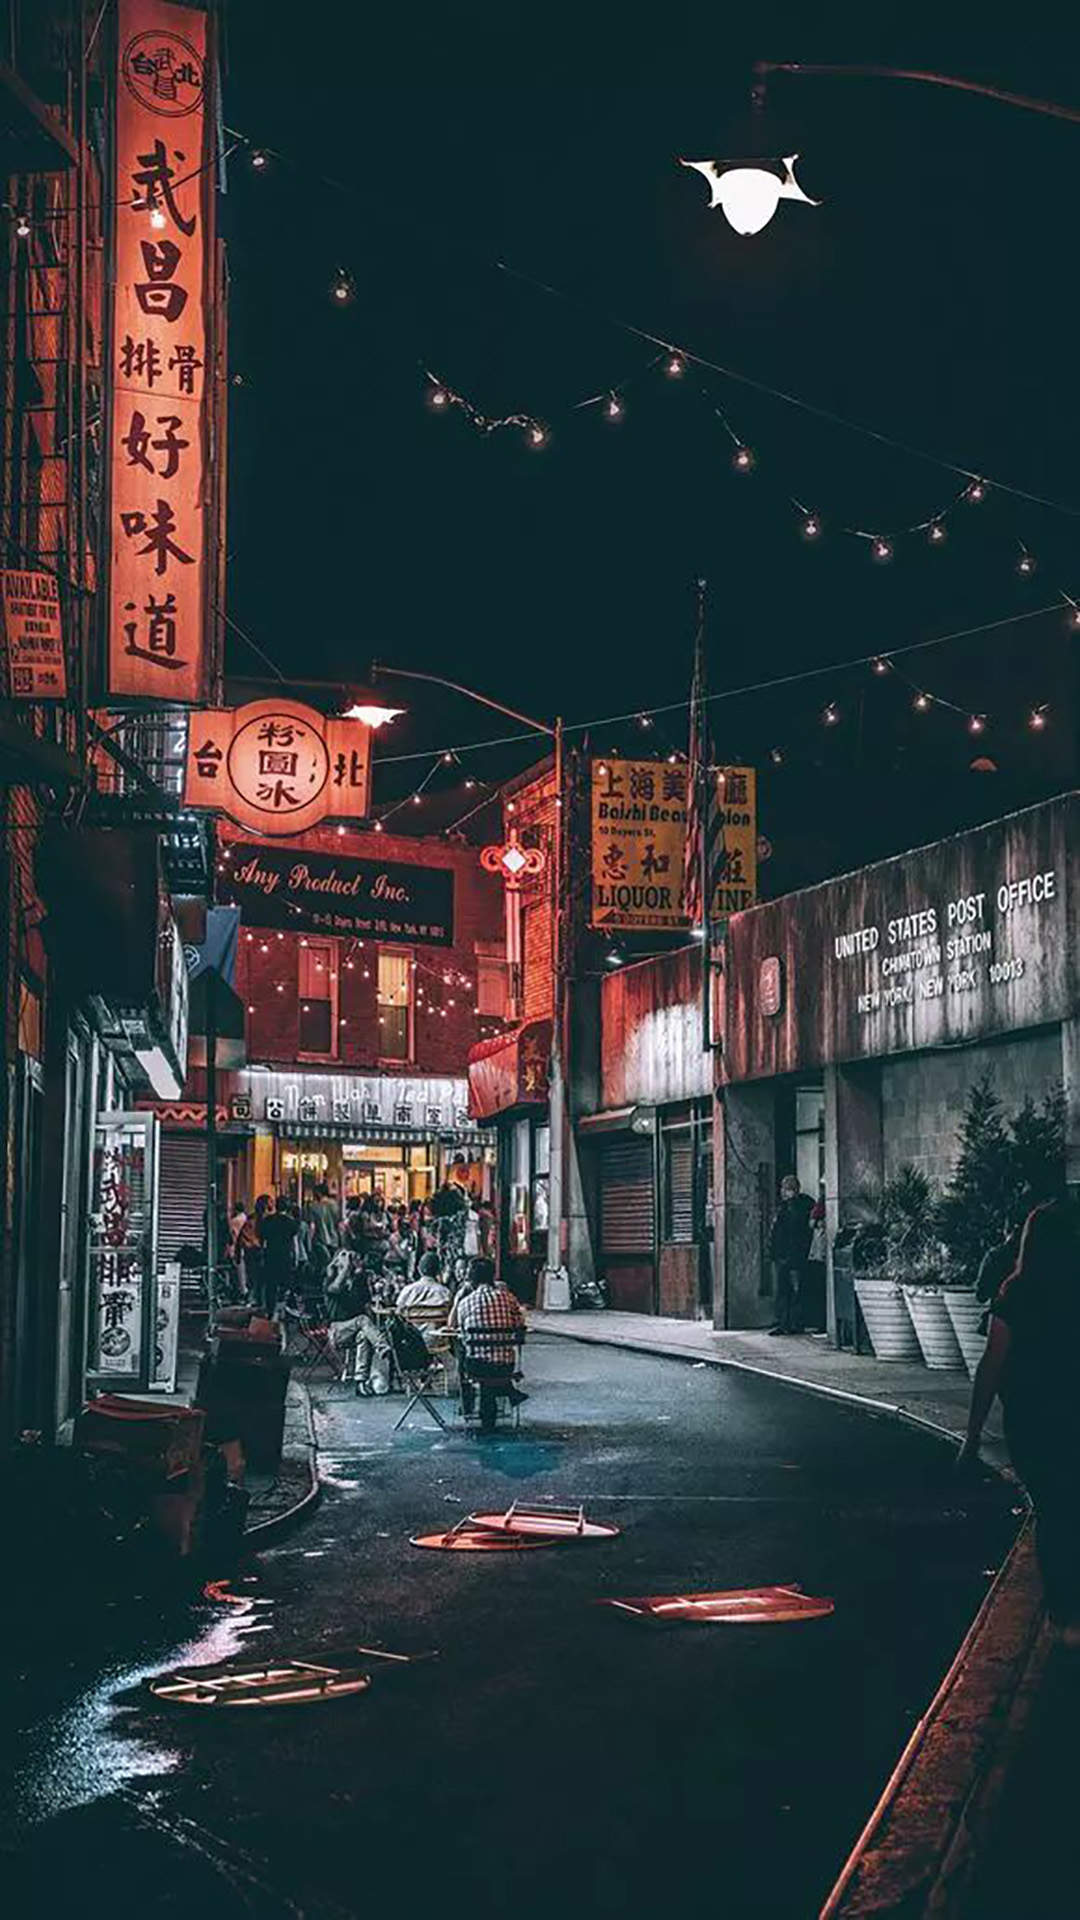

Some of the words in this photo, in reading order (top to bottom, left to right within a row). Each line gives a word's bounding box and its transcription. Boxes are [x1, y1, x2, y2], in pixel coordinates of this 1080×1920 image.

[234, 858, 280, 894] Any
[288, 864, 362, 896] Product
[371, 873, 411, 901] Inc.
[596, 885, 673, 912] LIQUOR
[716, 888, 752, 912] INE
[835, 928, 879, 959] UNITED
[888, 908, 936, 944] STATES
[948, 893, 985, 926] POST
[997, 872, 1055, 913] OFFICE
[881, 945, 940, 976] CHINATOWN
[947, 931, 992, 960] STATION
[858, 991, 880, 1013] NEW
[919, 976, 944, 998] NEW
[948, 970, 976, 993] YORK
[989, 958, 1024, 983] 10013
